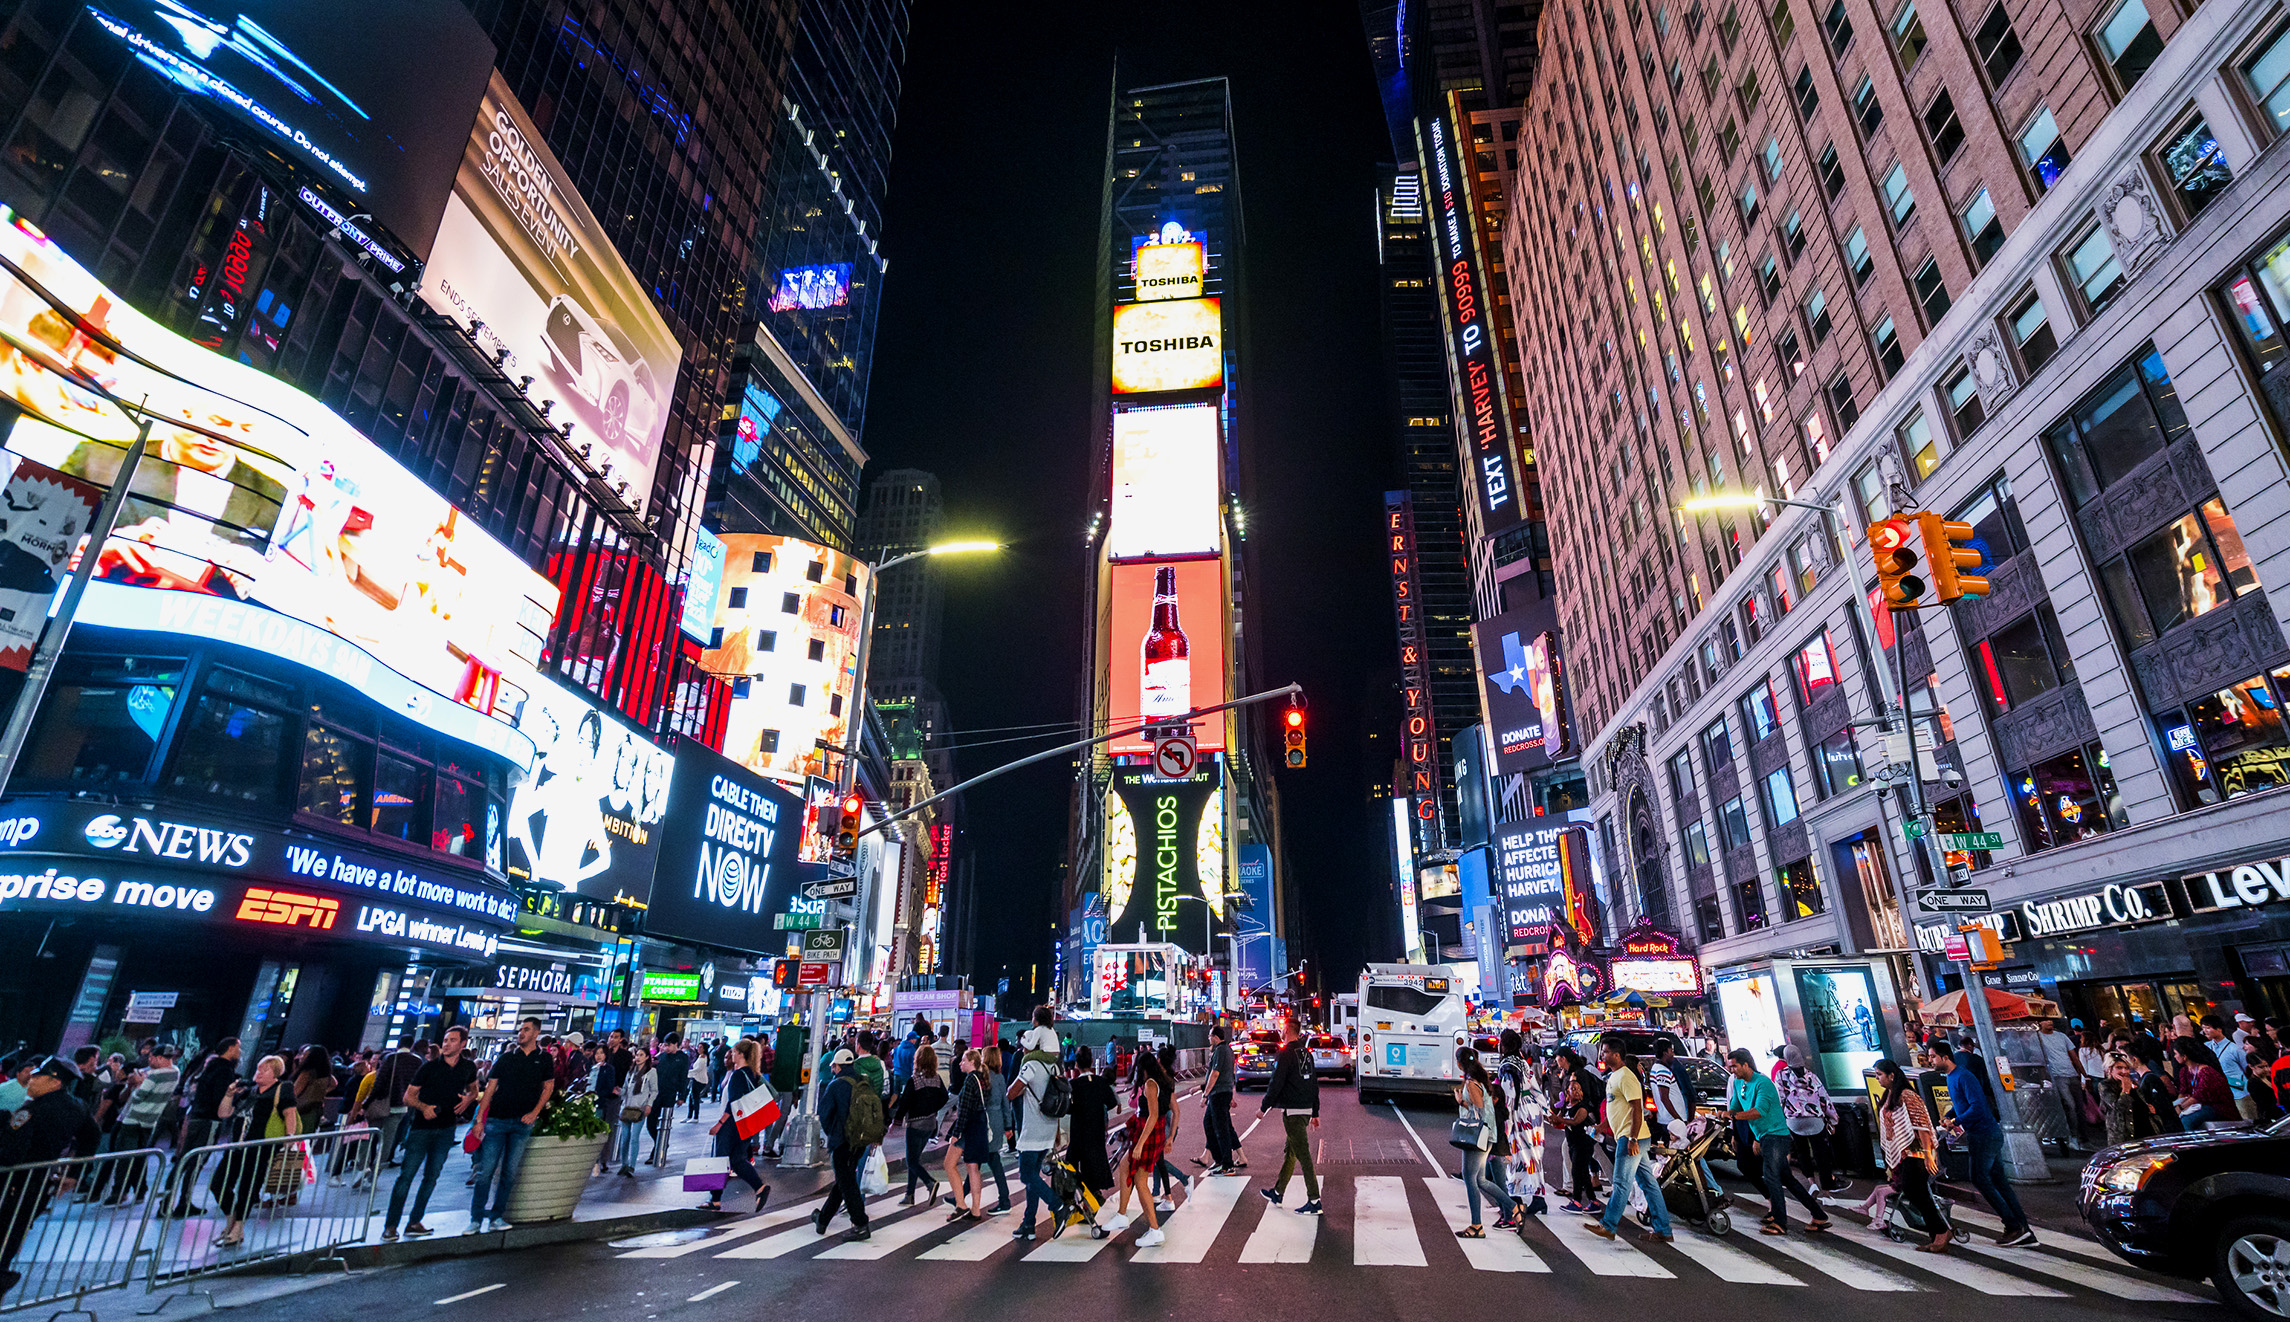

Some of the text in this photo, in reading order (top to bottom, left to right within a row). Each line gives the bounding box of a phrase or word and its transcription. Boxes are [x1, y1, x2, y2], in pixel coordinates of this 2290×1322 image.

[178, 61, 199, 77] on
[209, 79, 253, 110] closed
[251, 105, 293, 138] course.
[294, 131, 312, 151] Do
[311, 145, 330, 163] not
[328, 159, 366, 193] attempt.
[1431, 117, 1444, 149] TODAY.
[495, 111, 552, 199] GOLDEN
[1436, 147, 1451, 192] DONATION
[482, 151, 559, 259] SALES EVENT
[489, 131, 579, 259] OPPORTUNITY
[1446, 208, 1456, 217] A
[302, 189, 402, 271] OUTFRONT PRIME
[1447, 216, 1461, 244] MAKE
[1452, 244, 1462, 259] TO
[440, 279, 465, 312] ENDS
[1141, 276, 1198, 287] TOSHIBA
[1452, 260, 1476, 324] 90999
[1121, 335, 1214, 354] TOSHIBA
[1463, 324, 1484, 356] TO
[1483, 455, 1508, 511] TEXT
[158, 594, 333, 666] WEEKDAYS
[1391, 513, 1433, 820] ERNST & YOUNG
[1502, 724, 1541, 745] DONATE
[1124, 776, 1141, 784] THE
[711, 774, 750, 811] CABLE
[750, 792, 778, 824] THEN
[85, 822, 128, 840] abc
[123, 817, 254, 867] NEWS
[600, 812, 649, 845] MBITION
[704, 802, 775, 858] DIRECTV
[940, 824, 951, 858] Locker
[1502, 827, 1570, 850] HELP THO
[1956, 838, 1967, 848] W
[1972, 837, 1987, 848] 44
[1157, 795, 1178, 930] PISTACHIOS
[1504, 846, 1558, 866] AFFECTE
[330, 855, 378, 888] have
[378, 872, 392, 891] a
[393, 870, 417, 895] lot
[416, 881, 454, 905] more
[456, 889, 487, 912] work
[694, 841, 770, 914] NOW
[810, 883, 851, 895] ONE WAY
[1508, 878, 1559, 898] HARVEY.
[113, 880, 215, 912] move
[236, 888, 340, 930] ESPN
[1927, 896, 1984, 906] ONE WAY
[2023, 895, 2102, 936] SHRIMP
[357, 906, 407, 937] LPGA
[408, 917, 457, 945] winner
[786, 916, 795, 927] W
[798, 916, 810, 927] 44
[806, 951, 821, 959] BIKE
[1628, 943, 1669, 954] Hard Rock
[496, 965, 571, 993] SEPHORA
[643, 977, 698, 987] STARBUCKS
[651, 986, 686, 996] COFFEE
[1878, 970, 1893, 1010] Newsstand
[909, 993, 935, 1001] CREAM
[936, 992, 957, 1000] SHOP
